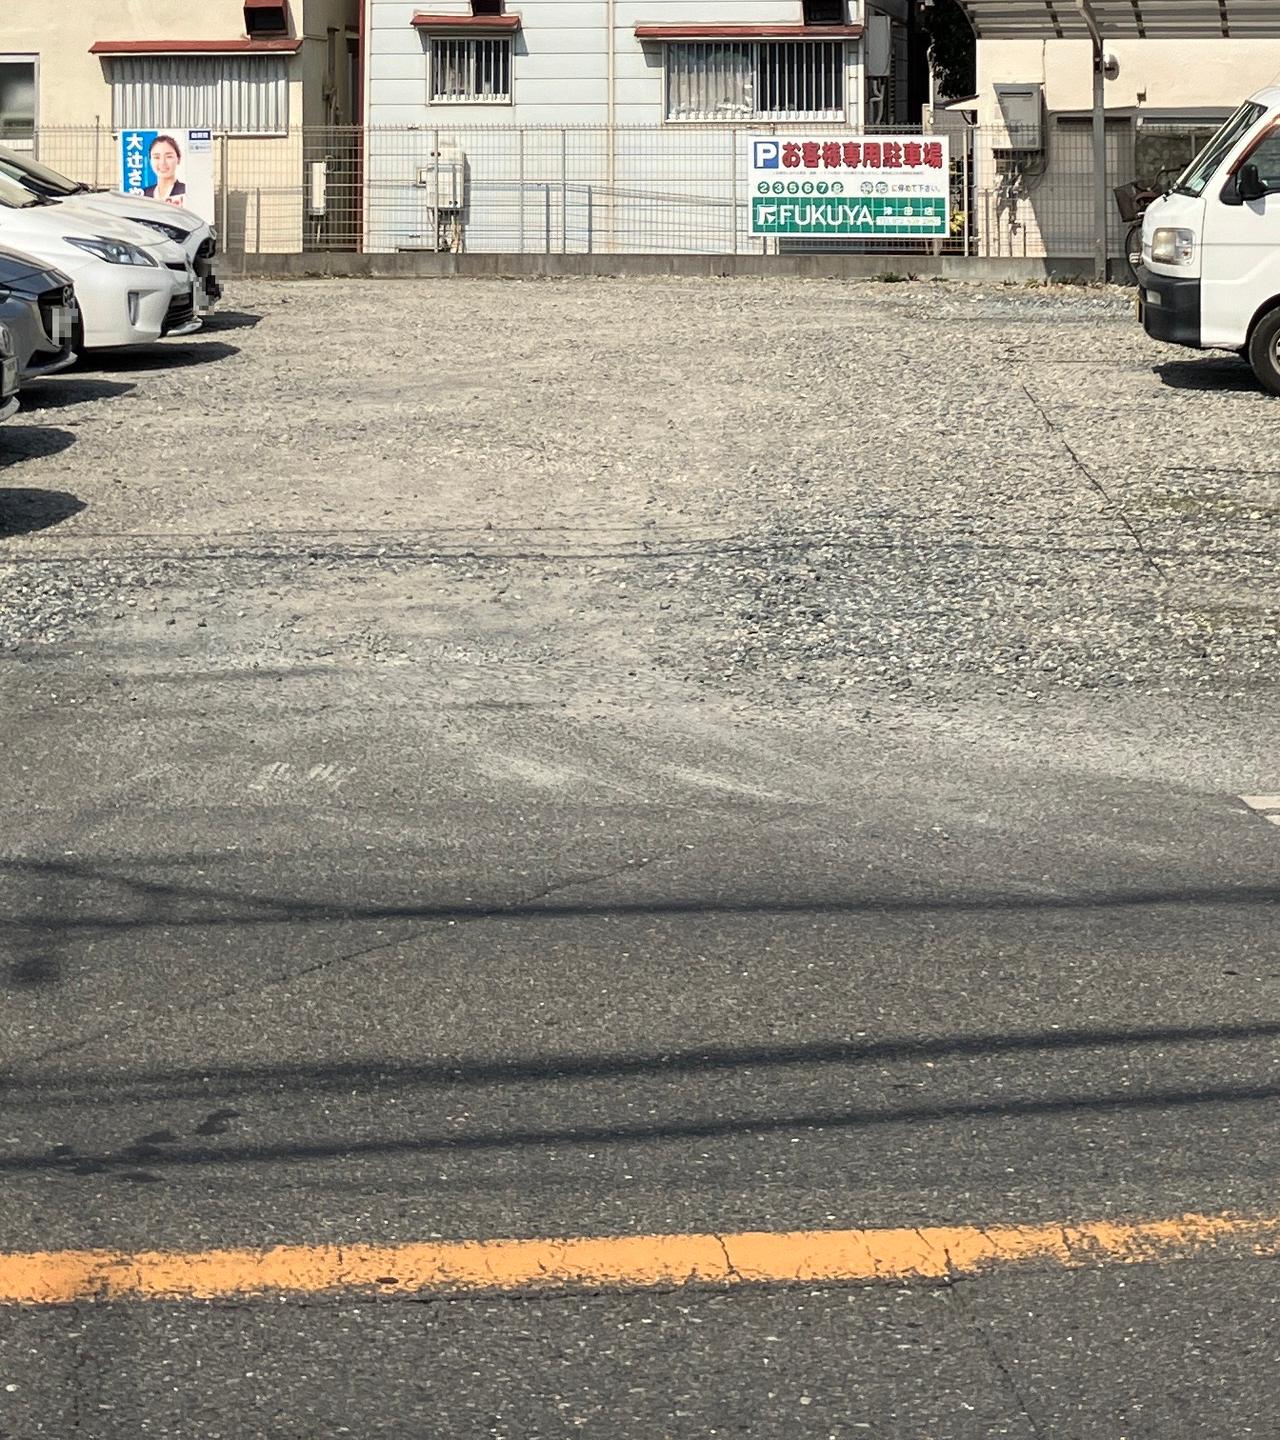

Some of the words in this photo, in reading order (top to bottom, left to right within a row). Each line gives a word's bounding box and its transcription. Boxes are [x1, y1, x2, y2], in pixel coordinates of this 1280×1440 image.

[756, 143, 778, 167] P
[782, 141, 943, 169] お客様専用駐車場
[780, 204, 873, 226] FUKUYA
